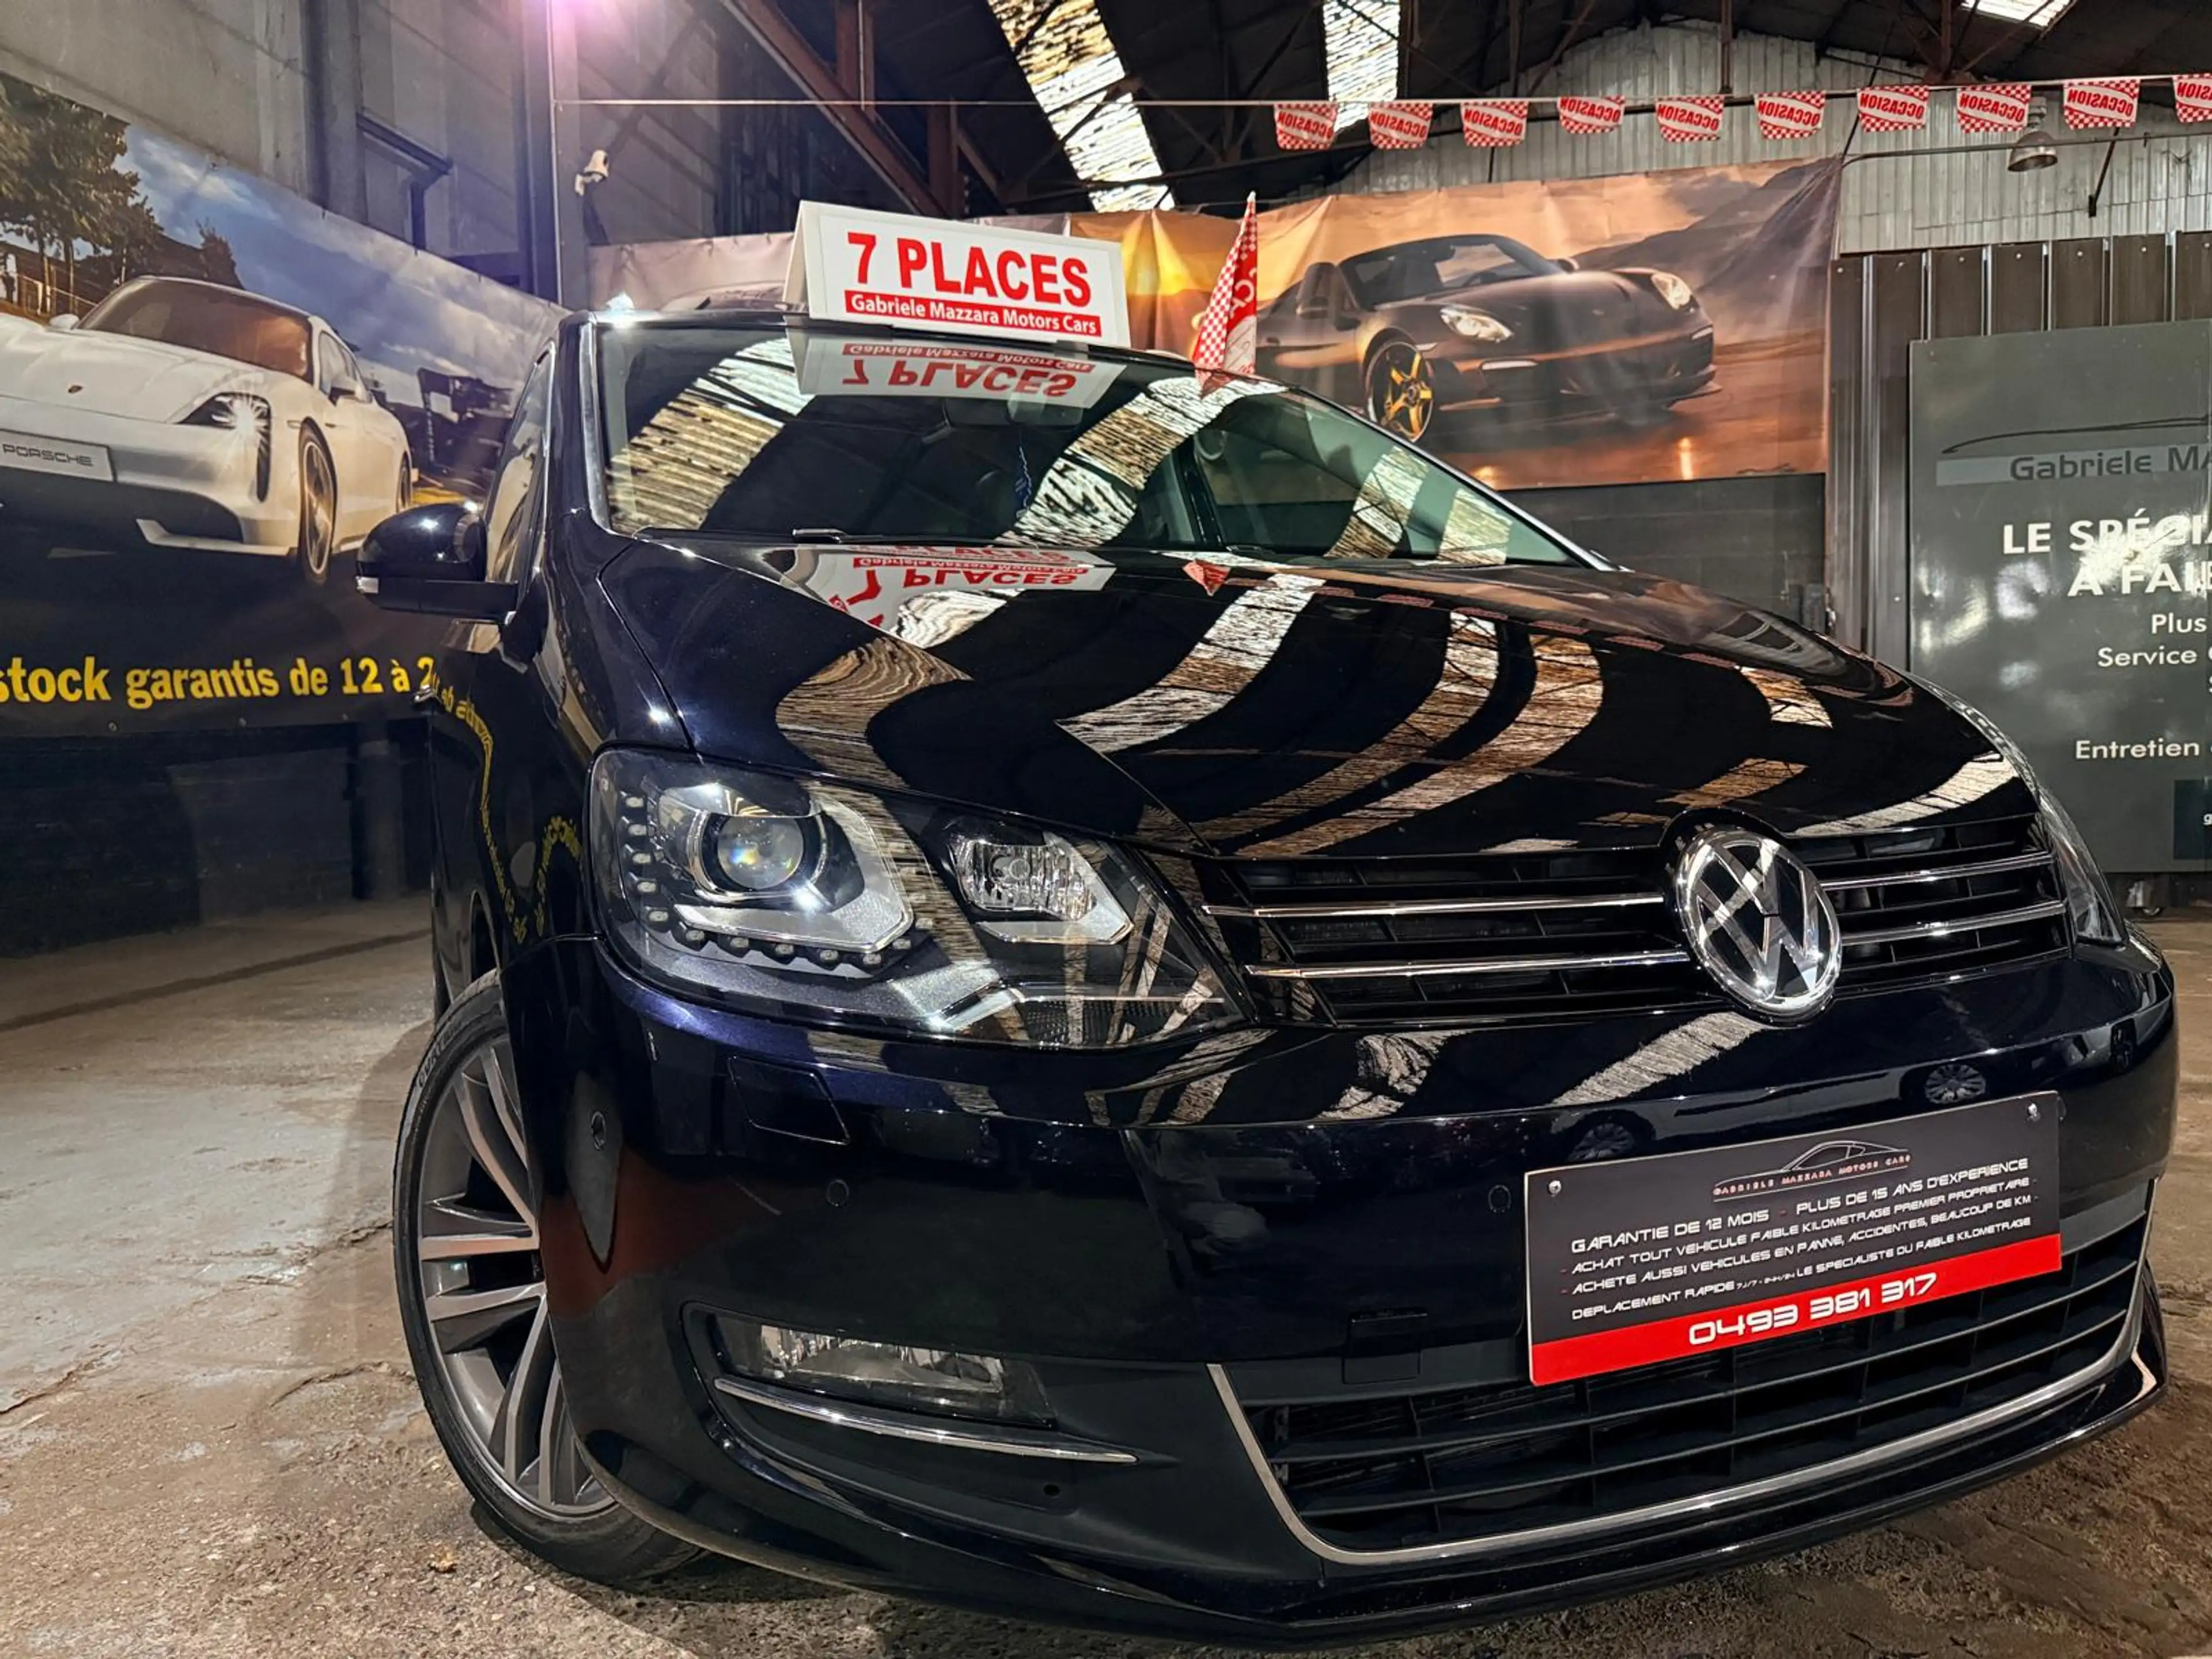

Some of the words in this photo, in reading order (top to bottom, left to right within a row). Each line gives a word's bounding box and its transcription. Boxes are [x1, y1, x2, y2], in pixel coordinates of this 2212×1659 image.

[847, 232, 877, 284] 7
[897, 238, 1092, 307] PLACES
[851, 295, 925, 318] Gabriele
[930, 302, 999, 325] Mazzara
[1003, 309, 1059, 330] Motors
[1062, 316, 1097, 334] Cars
[2010, 450, 2153, 482] Gabriele
[2002, 522, 2051, 555] LE
[2152, 612, 2207, 634] Plus
[126, 658, 279, 711] garantis
[289, 657, 329, 696] de
[340, 657, 384, 695] 12
[391, 660, 411, 693] à
[2097, 646, 2198, 668] Service
[2075, 738, 2199, 759] Entretien
[1571, 1226, 1669, 1253] GARANTIE
[1674, 1220, 1700, 1237] DE
[1705, 1217, 1722, 1232] 12
[1728, 1209, 1770, 1228] MOIS
[1796, 1196, 1841, 1215] PLUS
[1846, 1191, 1868, 1206] DE
[1872, 1187, 1888, 1200] 15
[1892, 1179, 1923, 1196] ANS
[1927, 1158, 2028, 1189] D'EXPERIENCE
[1571, 1256, 1625, 1274] ACHAT
[1629, 1248, 1672, 1264] TOUT
[1676, 1234, 1748, 1256] VEHICULE
[1751, 1225, 1799, 1242] FAIBLE
[1802, 1206, 1891, 1233] KILOMETRAGE
[1893, 1195, 1946, 1214] PREMIER
[1948, 1177, 2030, 1203] PROPRIETAIRE
[1572, 1274, 1637, 1295] ACHETE
[1641, 1264, 1687, 1282] AUSSI
[1691, 1249, 1771, 1274] VEHICULES
[1774, 1245, 1794, 1258] EN
[1797, 1234, 1845, 1254] PANNE,
[1848, 1215, 1928, 1243] ACCIDENTES,
[1930, 1202, 1994, 1225] BEAUCOUP
[1996, 1198, 2012, 1210] DE
[2014, 1194, 2032, 1206] KM
[1572, 1291, 1681, 1320] DEPLACEMENT
[1684, 1280, 1735, 1300] RAPIDE
[1797, 1265, 1813, 1277] LE
[1816, 1248, 1894, 1274] SPECIALISTE
[1896, 1243, 1913, 1256] DU
[1916, 1233, 1955, 1251] FAIBLE
[1957, 1217, 2031, 1241] KILOMETRAGE
[1689, 1303, 1799, 1346] 0493
[1809, 1287, 1872, 1320] 381
[1881, 1271, 1938, 1304] 317
